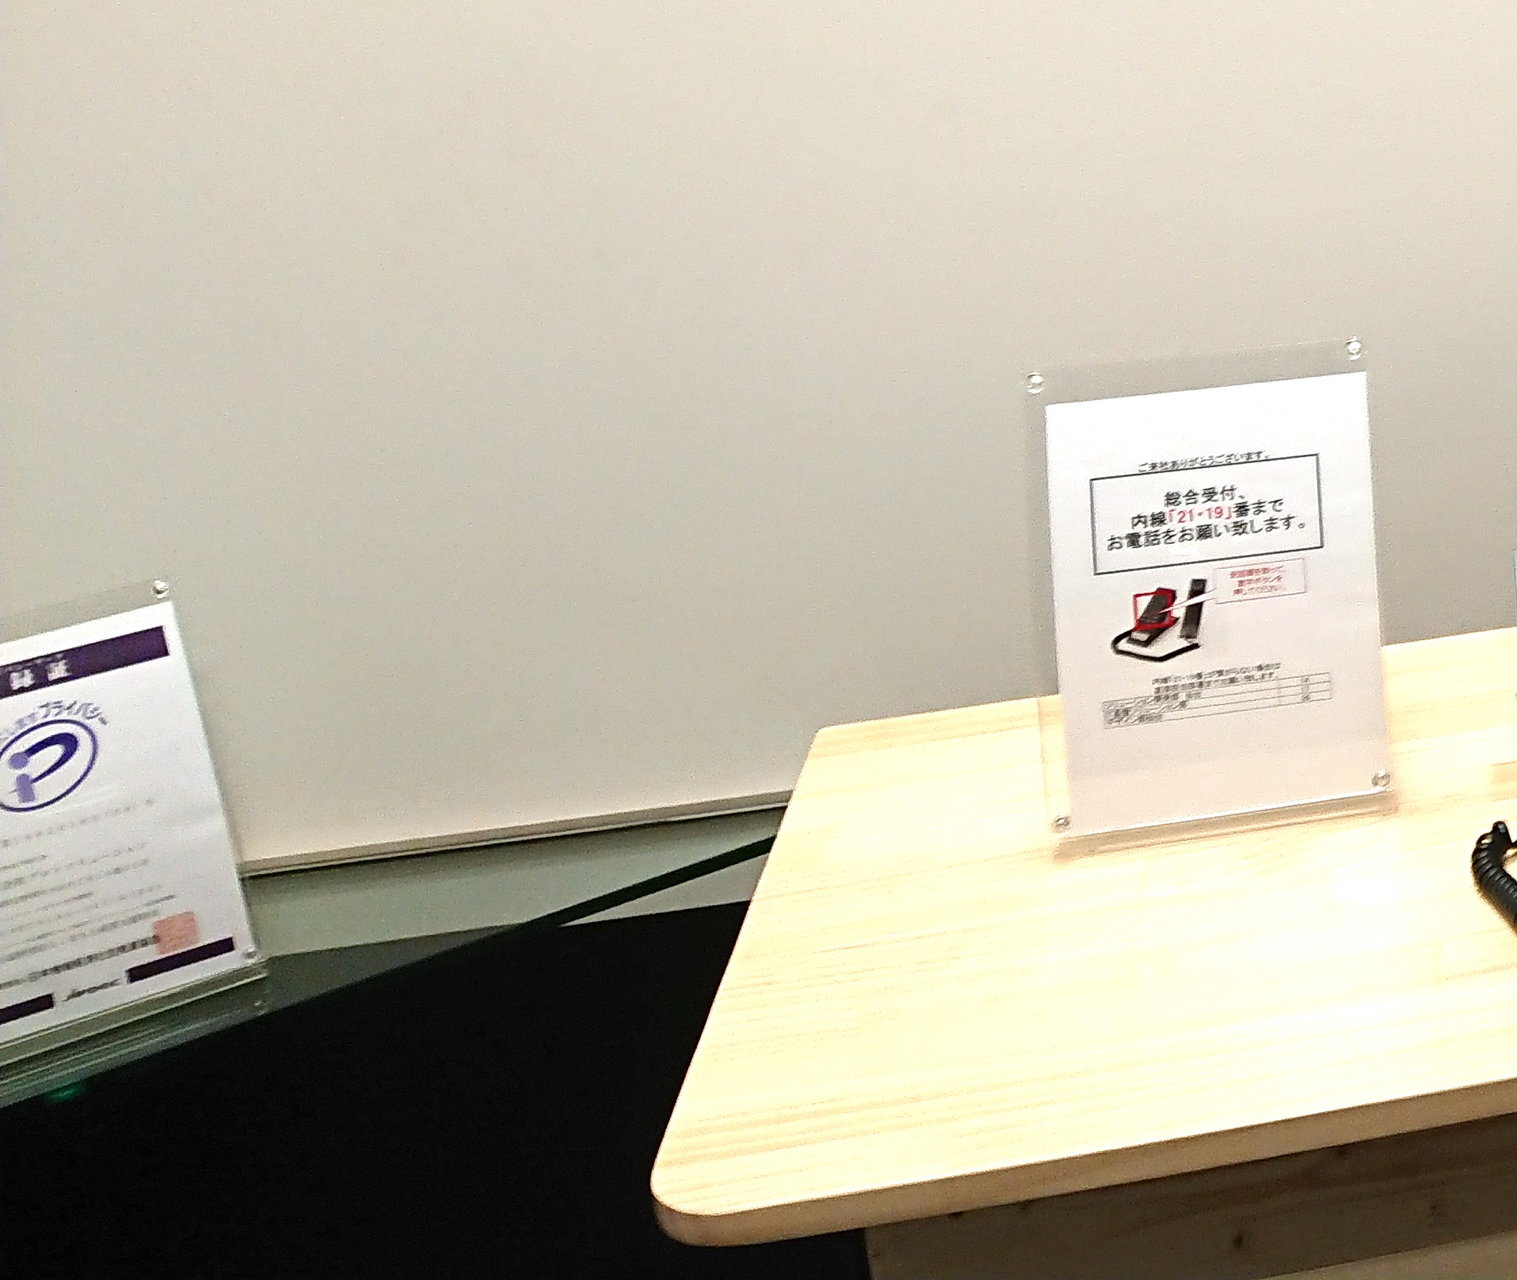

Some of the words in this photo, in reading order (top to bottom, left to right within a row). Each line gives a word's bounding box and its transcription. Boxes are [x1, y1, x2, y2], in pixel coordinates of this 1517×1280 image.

[1163, 485, 1246, 508] 総合受付、
[1106, 514, 1307, 552] お電話をお願い致します。
